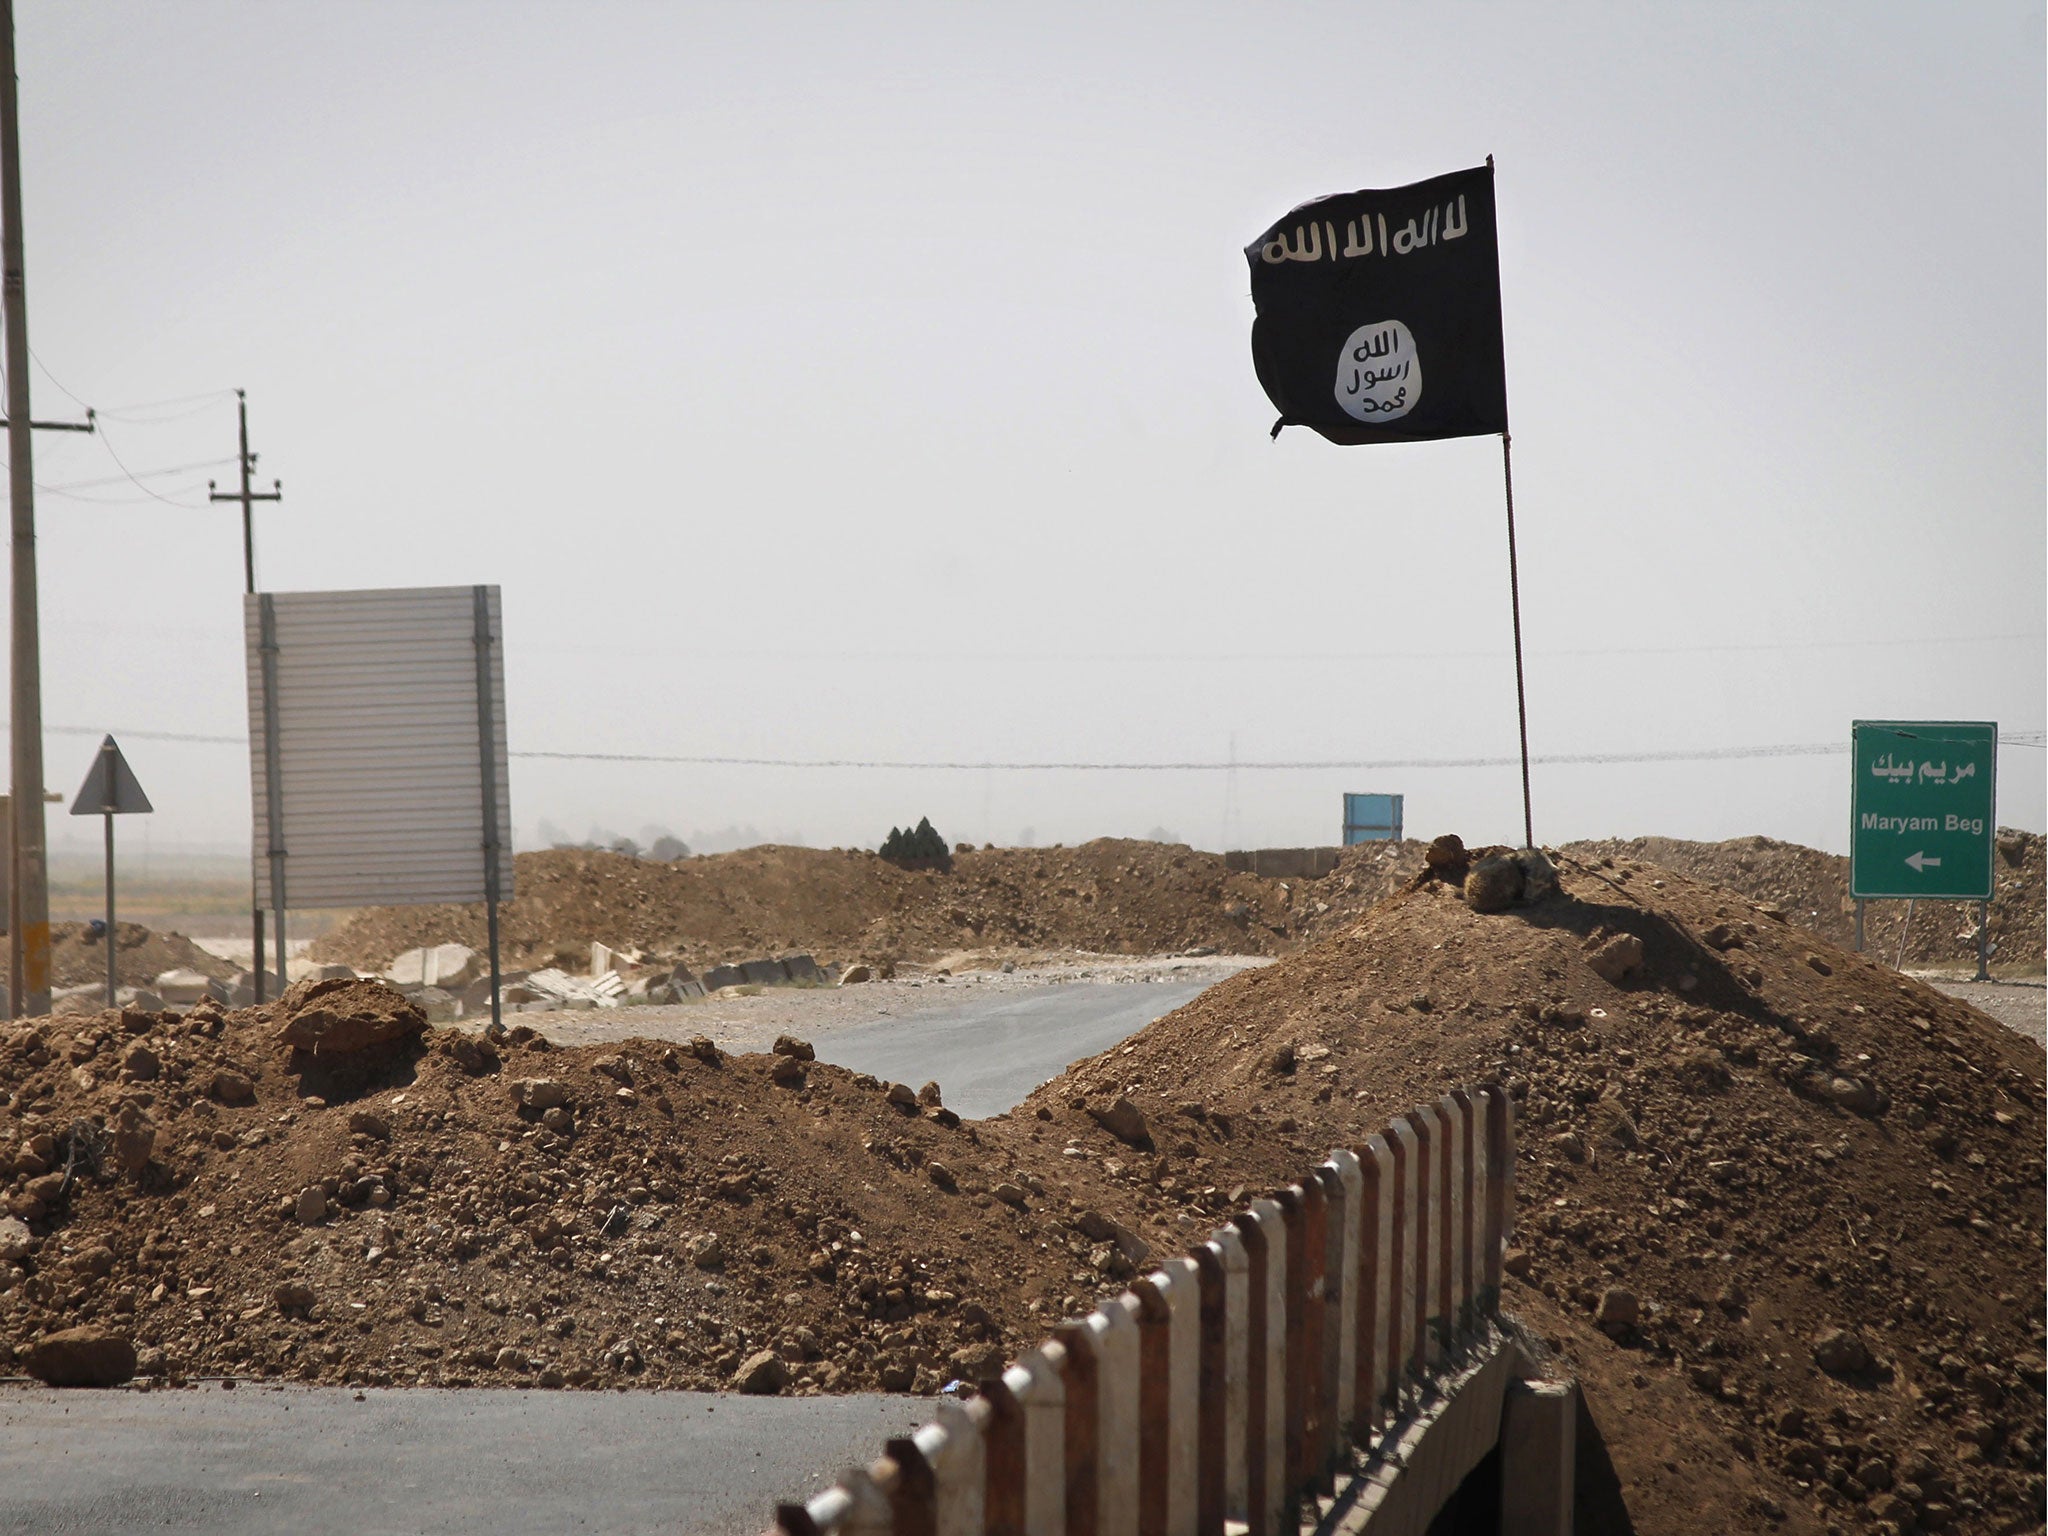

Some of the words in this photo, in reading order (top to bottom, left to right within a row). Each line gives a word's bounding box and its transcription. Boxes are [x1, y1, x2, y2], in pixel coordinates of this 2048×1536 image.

[1442, 194, 1468, 240] لا
[1262, 220, 1337, 264] الله
[1353, 328, 1399, 362] الله
[1363, 386, 1407, 413] محمد
[1918, 760, 1976, 785] مريم
[1861, 813, 1938, 834] Maryam
[1944, 814, 1983, 835] Beg
